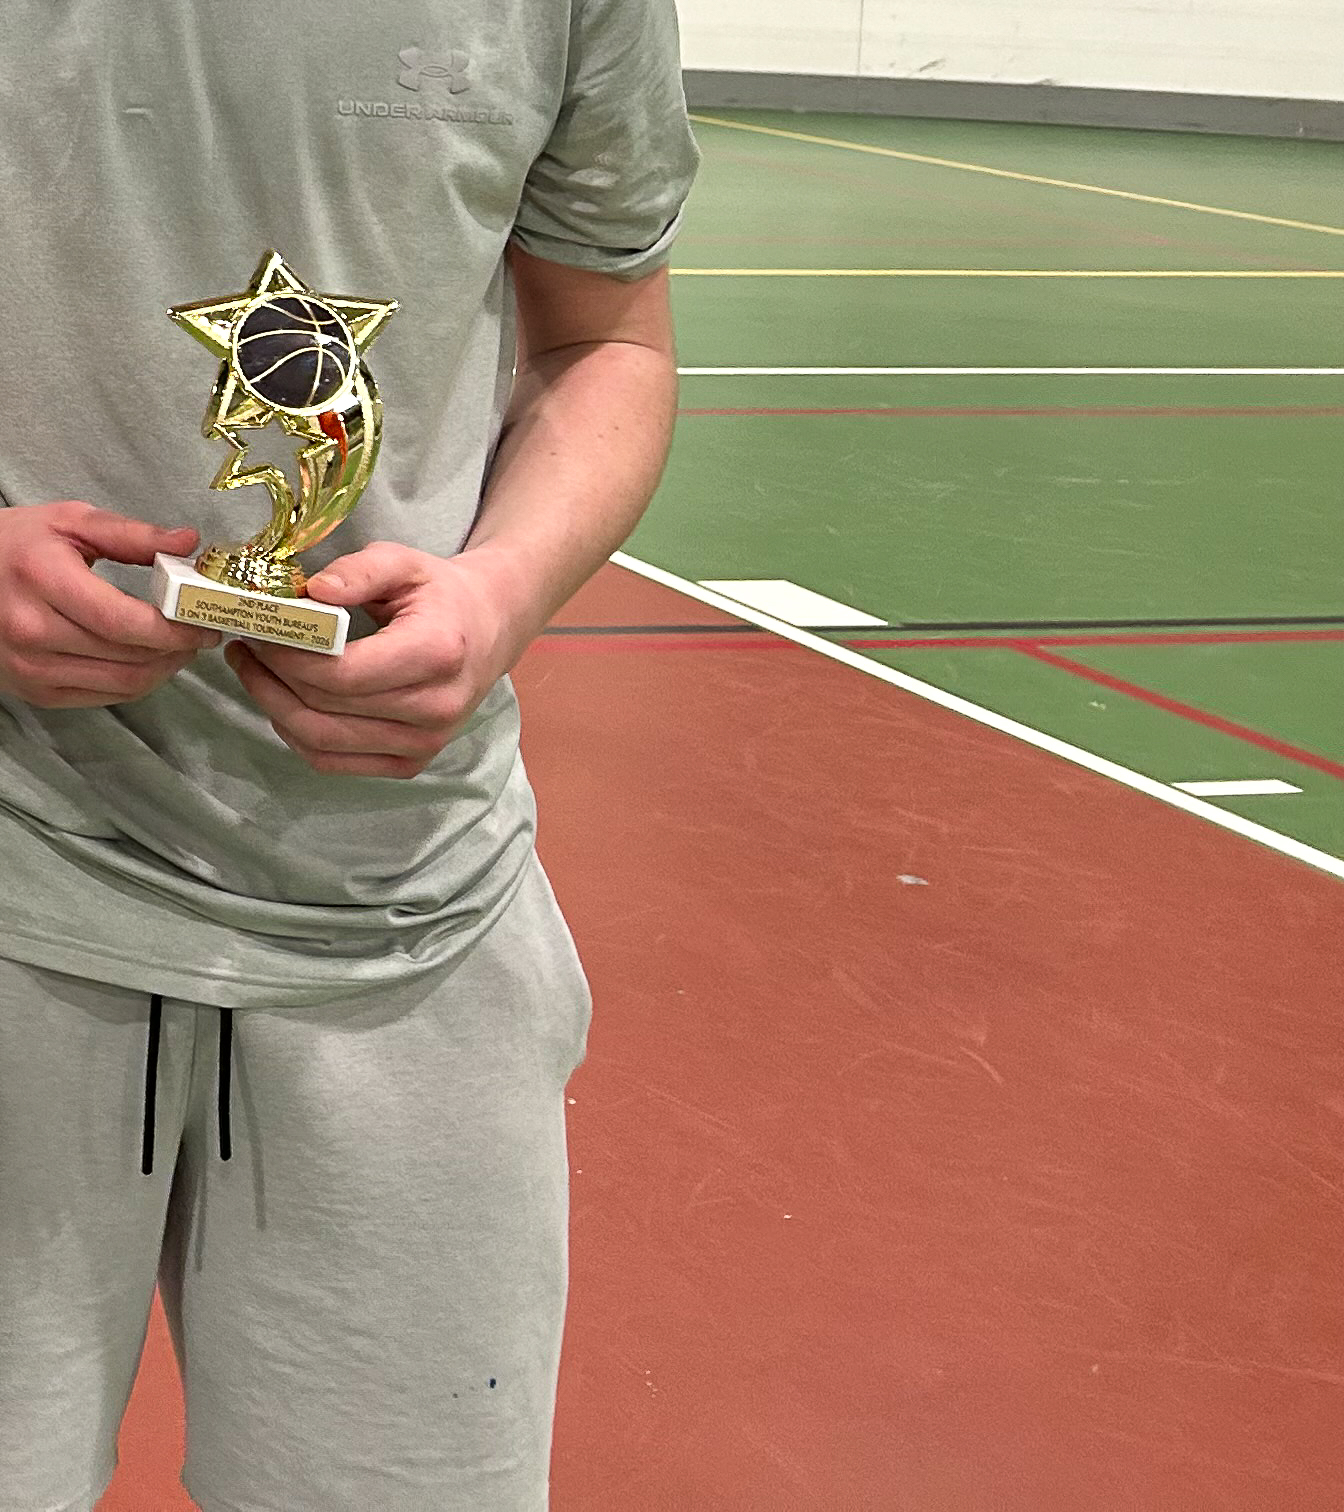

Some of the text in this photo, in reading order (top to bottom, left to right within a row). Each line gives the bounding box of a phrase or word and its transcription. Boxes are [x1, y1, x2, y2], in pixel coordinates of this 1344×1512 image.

[337, 99, 422, 120] UNDER
[195, 599, 254, 619] SOUTHAMPTON
[255, 613, 282, 625] YOUTH
[238, 598, 280, 612] 2ND PLACE
[179, 608, 186, 616] 3
[187, 610, 200, 619] ON
[201, 613, 207, 621] 3
[207, 614, 252, 631] BASKETBALL
[252, 623, 306, 641] TOURNAMENT
[310, 635, 330, 647] 2026
